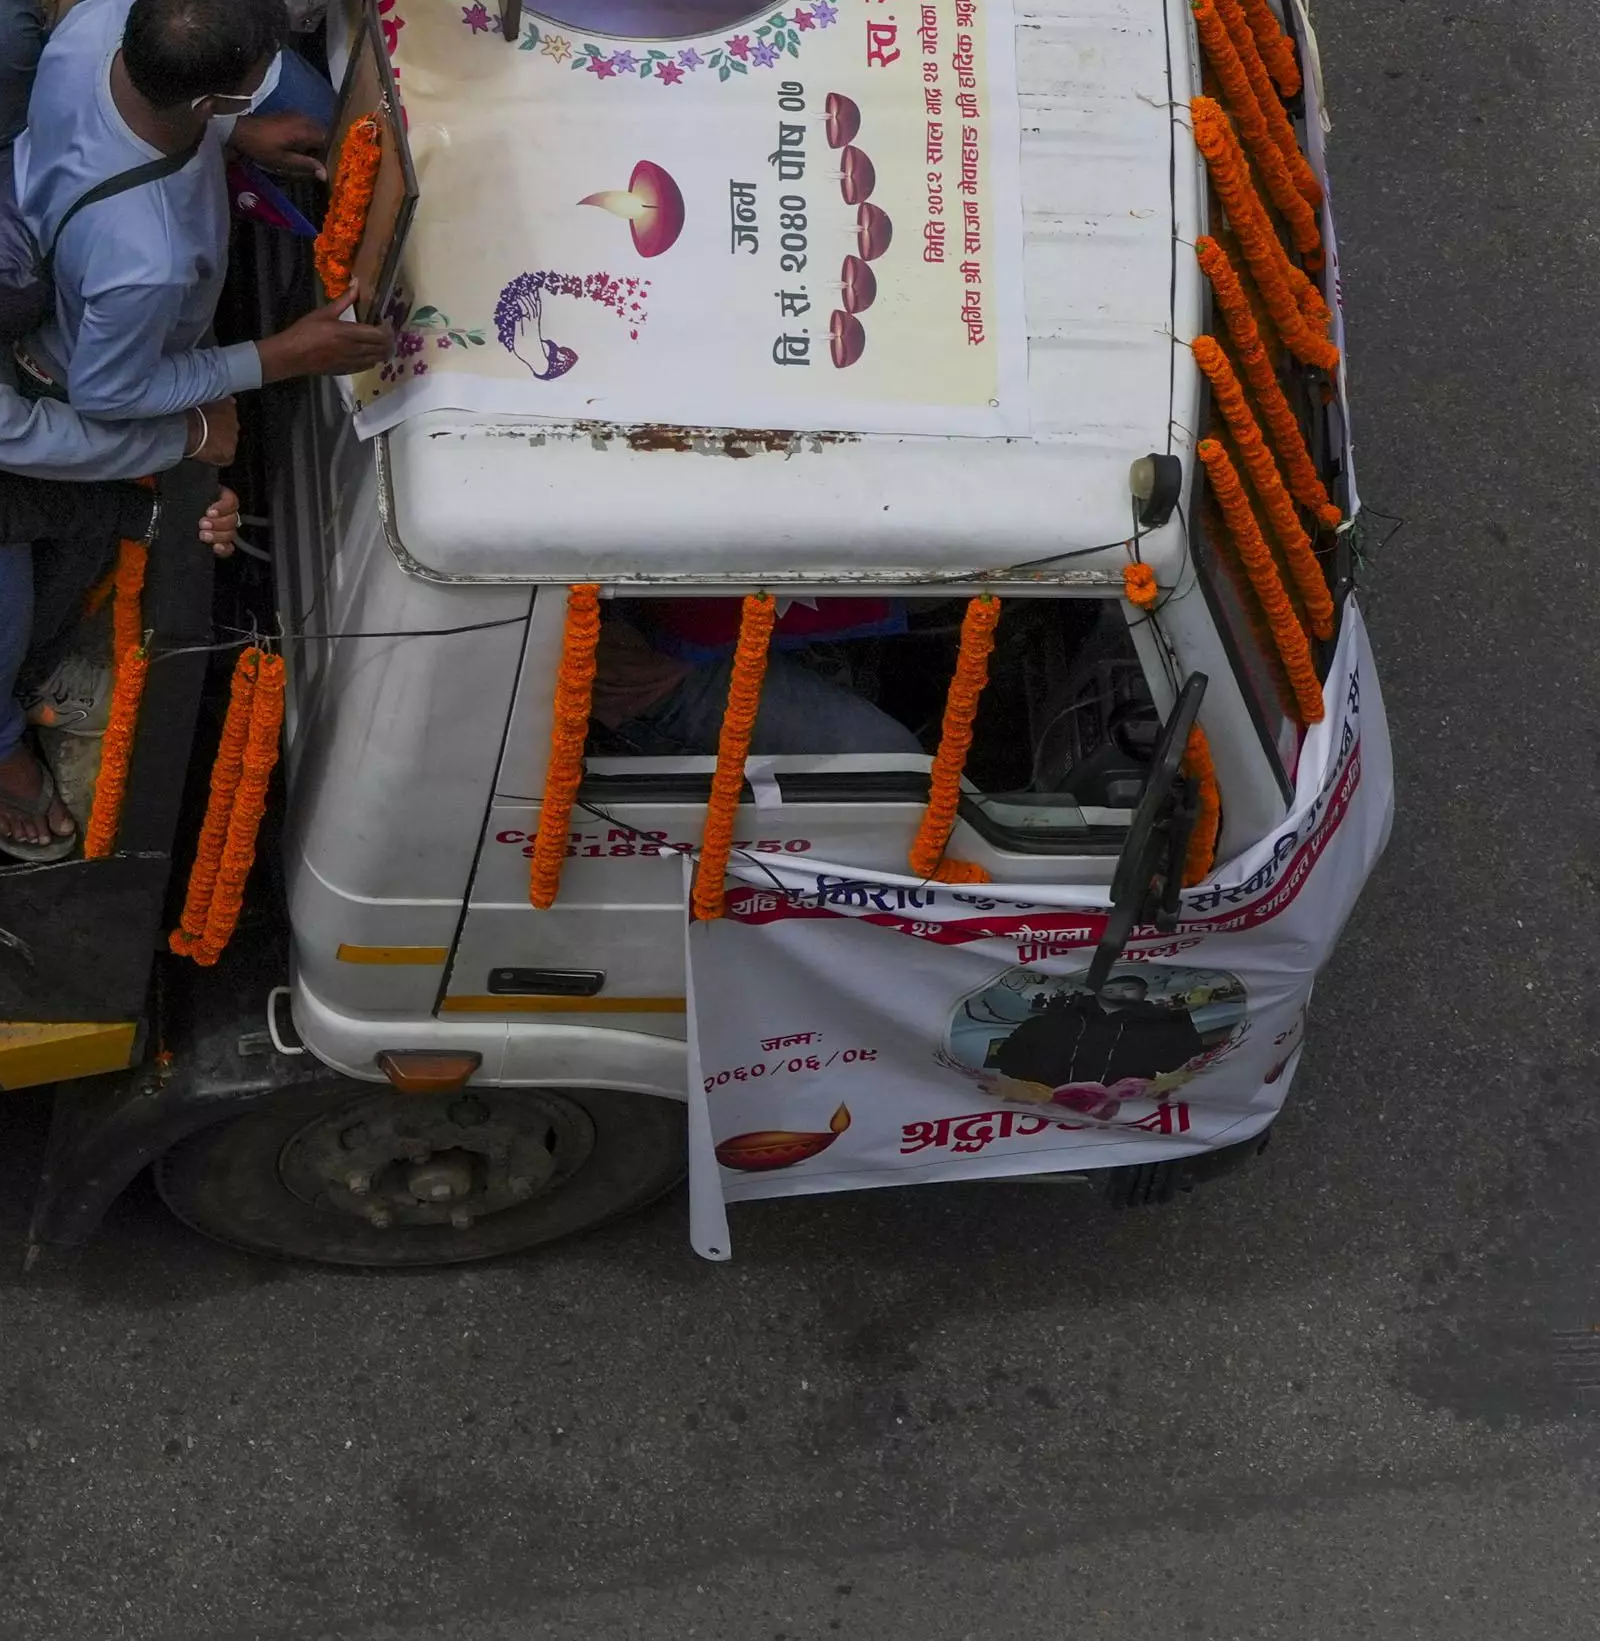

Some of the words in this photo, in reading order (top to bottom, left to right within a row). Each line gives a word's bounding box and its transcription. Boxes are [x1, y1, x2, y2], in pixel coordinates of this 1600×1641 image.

[867, 15, 900, 67] स्व.
[918, 5, 939, 53] गतेका
[923, 62, 939, 82] २४
[952, 34, 975, 88] हार्दिक
[777, 81, 804, 112] ०७
[924, 88, 942, 115] भाद्र
[955, 94, 979, 118] प्रति
[768, 122, 806, 180] पौष
[926, 122, 943, 164] साल
[957, 125, 978, 194] मेवाहाङ
[928, 172, 944, 215] २०८२
[730, 179, 758, 254] जन्म
[780, 195, 807, 272] २०४०
[962, 202, 981, 254] साजन
[923, 221, 945, 264] मिति
[959, 261, 982, 284] श्री
[774, 285, 810, 317] सं.
[772, 328, 810, 366] वि.
